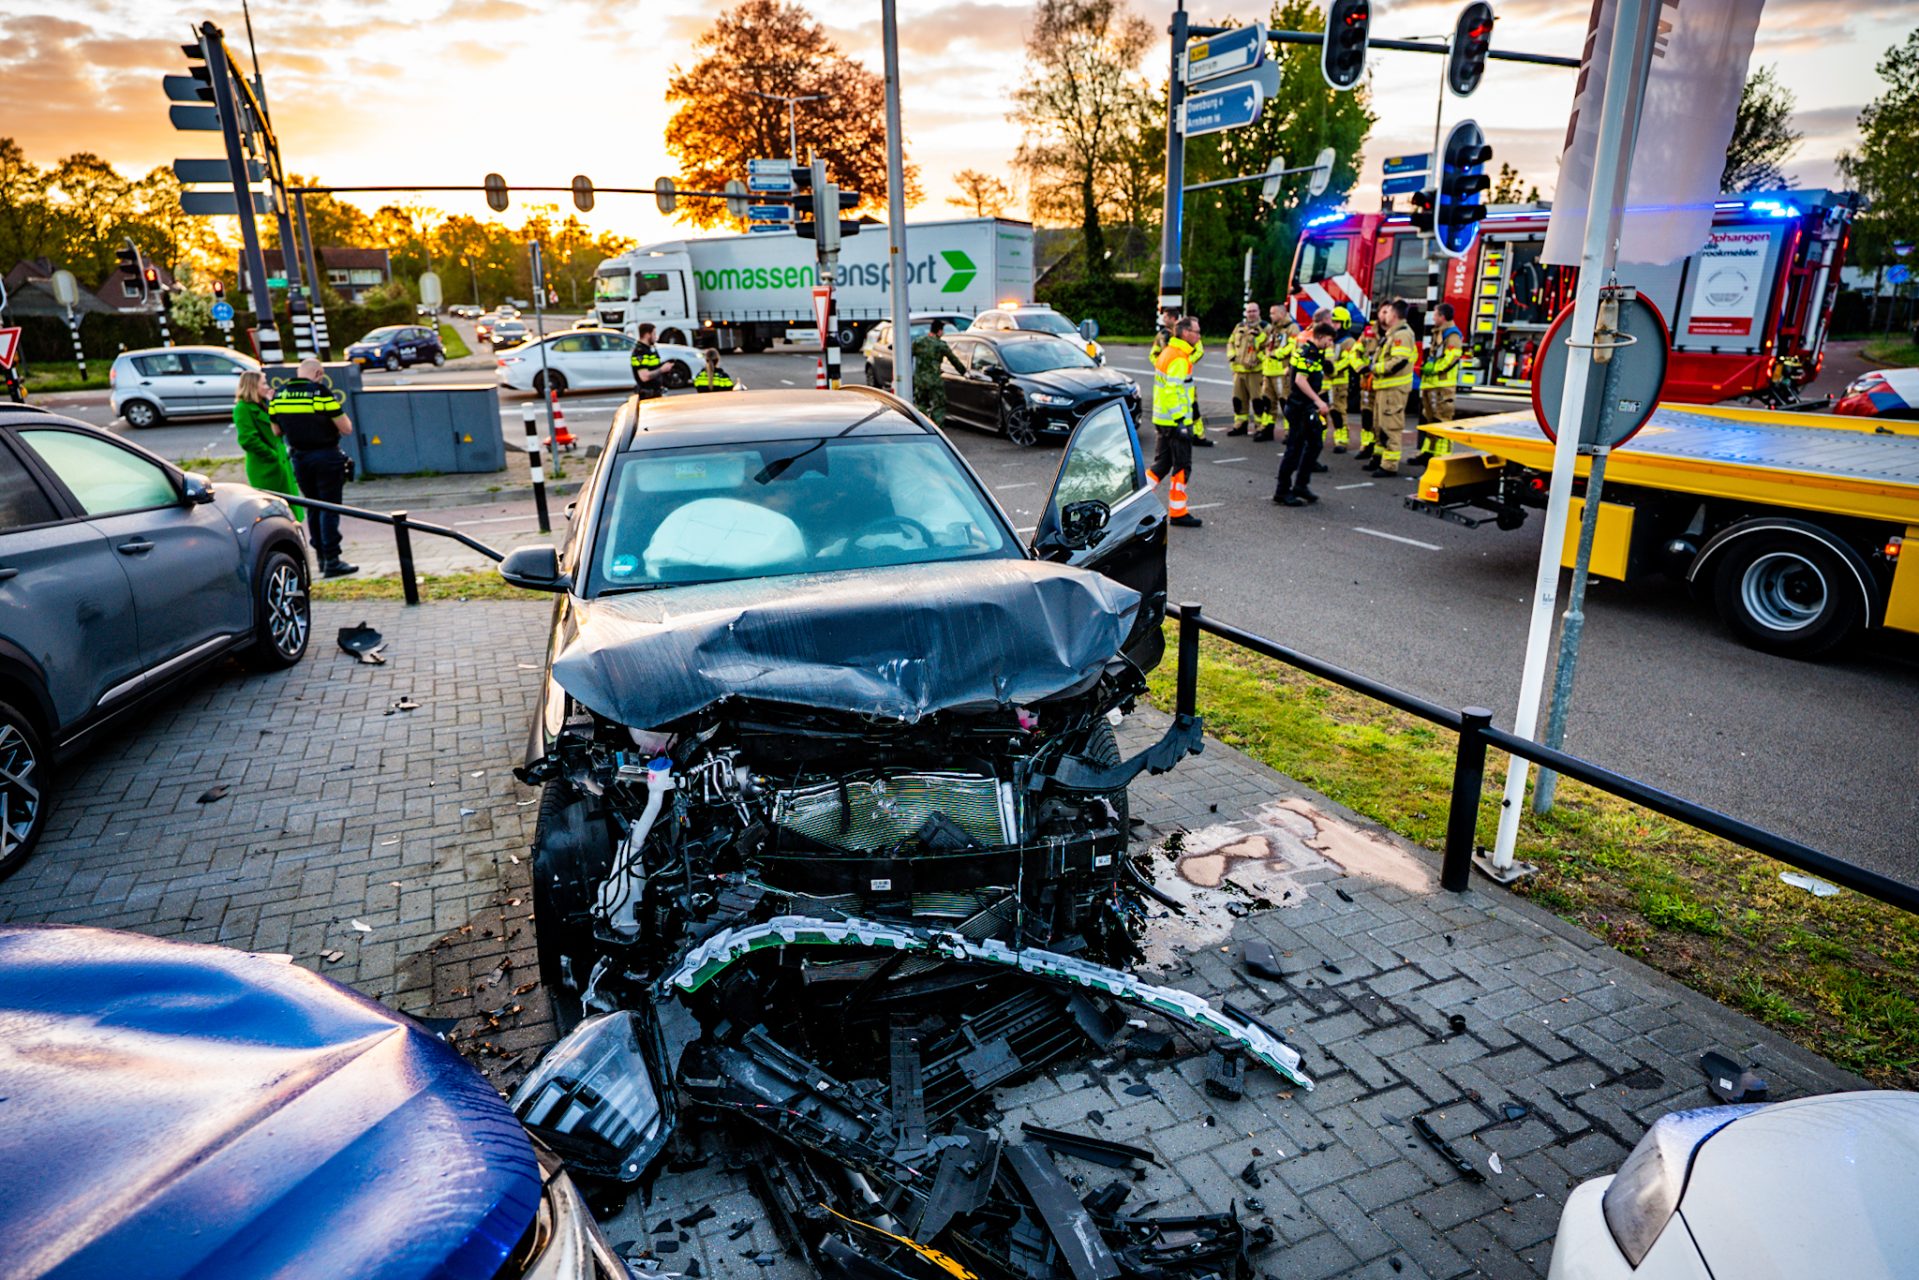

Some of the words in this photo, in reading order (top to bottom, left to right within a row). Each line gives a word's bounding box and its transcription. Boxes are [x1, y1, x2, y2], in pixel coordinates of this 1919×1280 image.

[1191, 61, 1217, 75] Centrum
[1187, 98, 1217, 113] Doesburg
[1187, 115, 1212, 127] Arnhem
